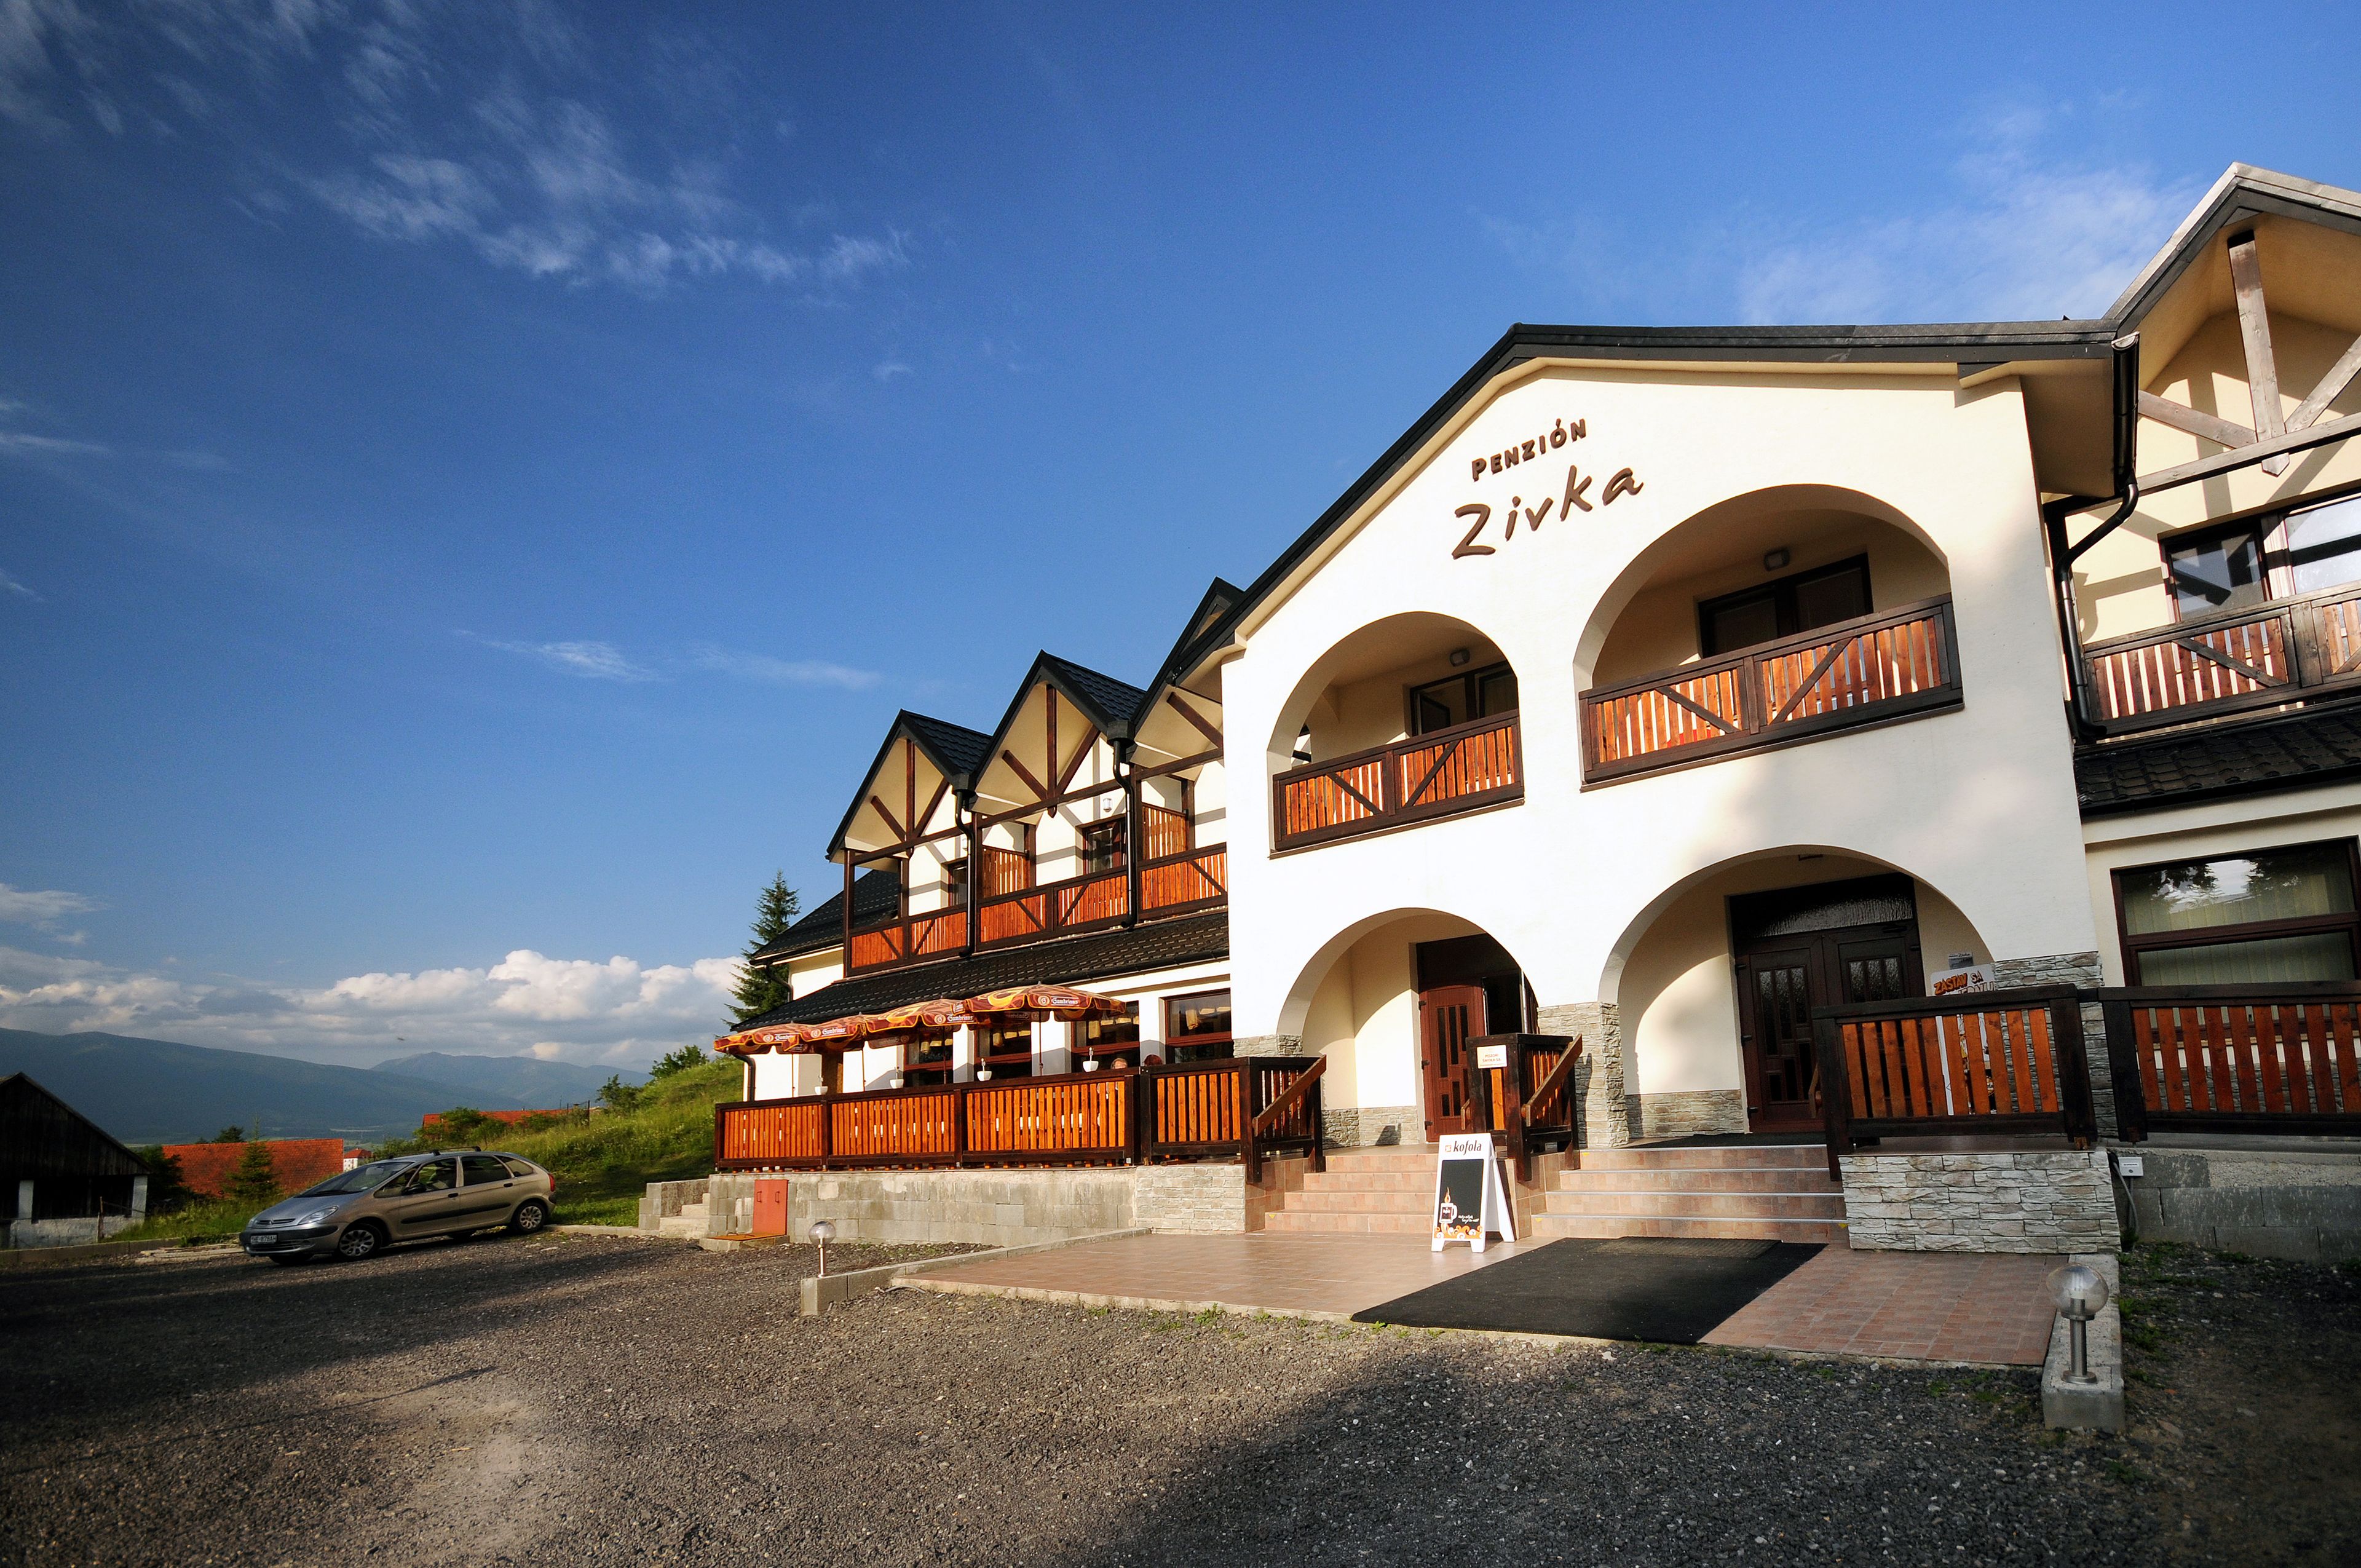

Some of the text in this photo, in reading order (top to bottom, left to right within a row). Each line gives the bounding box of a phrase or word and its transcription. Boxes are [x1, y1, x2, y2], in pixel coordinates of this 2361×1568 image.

[1471, 418, 1586, 482] PENZIÓN
[1452, 465, 1643, 560] Zivka
[1934, 970, 1983, 996] ZASTAV SA
[1453, 1140, 1482, 1155] kofola
